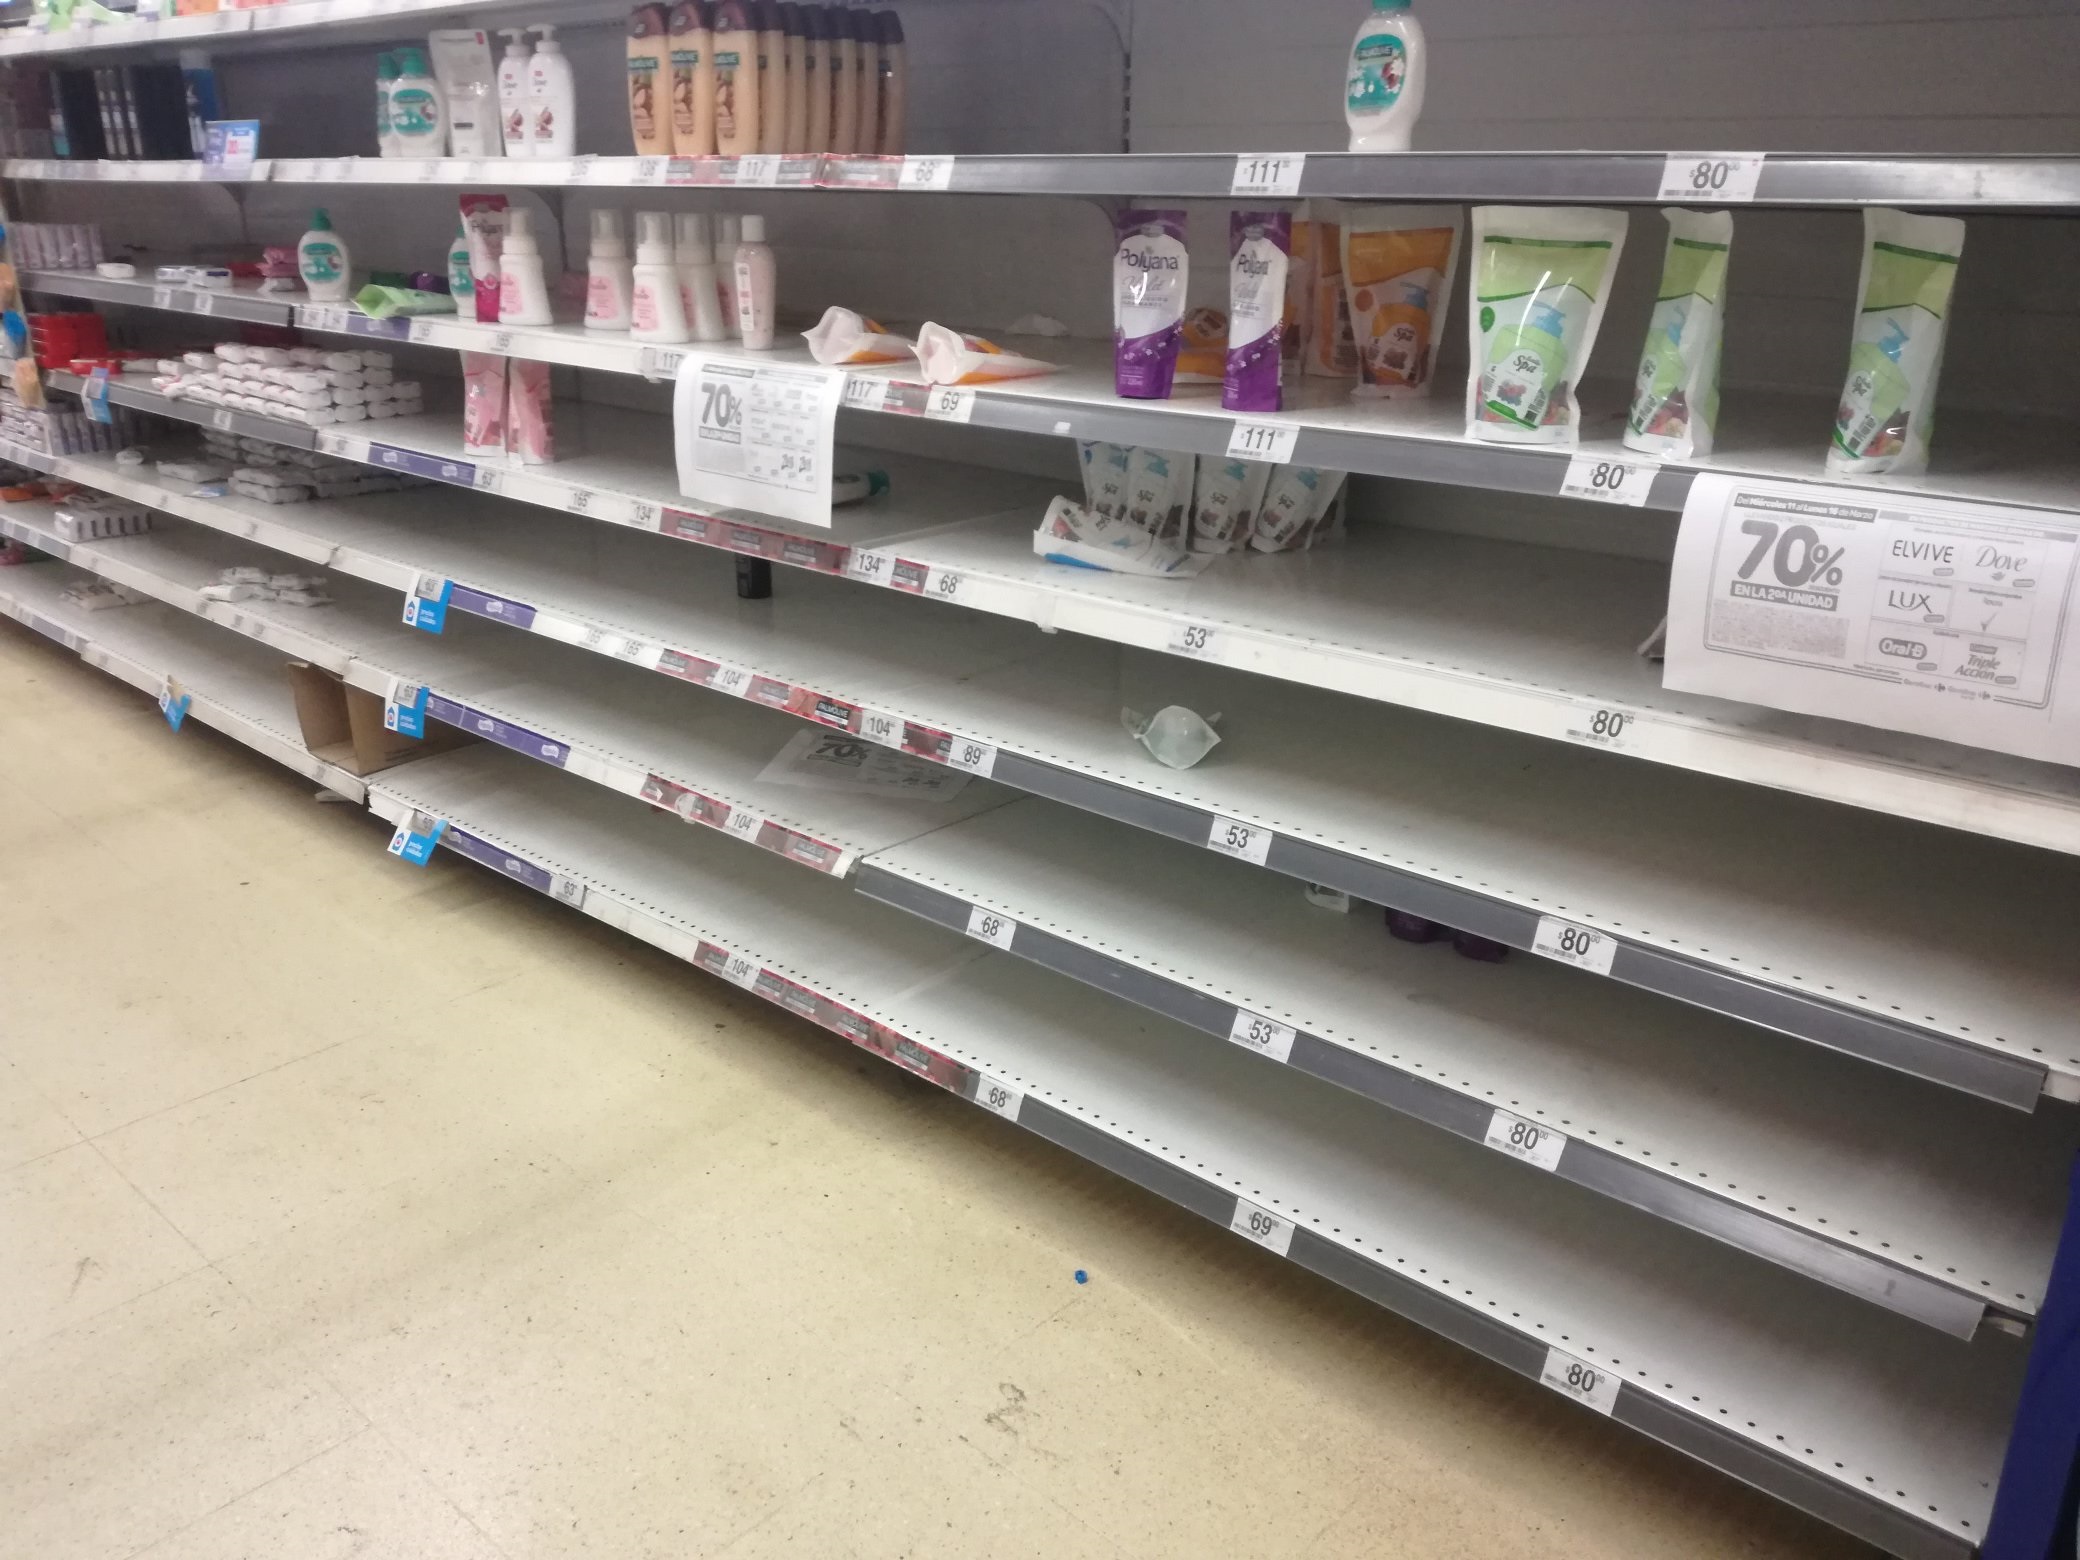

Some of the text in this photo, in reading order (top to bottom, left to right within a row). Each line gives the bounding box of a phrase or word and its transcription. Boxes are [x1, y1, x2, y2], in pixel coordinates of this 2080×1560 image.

[1120, 248, 1179, 272] Polyana
[701, 382, 743, 428] 70%
[1736, 518, 1846, 588] 70%
[1892, 539, 1955, 564] ELVIVE
[1975, 545, 2029, 573] Dove
[1734, 583, 1751, 597] EN
[1751, 585, 1767, 600] LA
[1787, 590, 1834, 609] UNIDAD
[1888, 589, 1933, 614] LUX
[1881, 638, 1925, 660] Oral-B
[1968, 653, 2001, 671] Triple
